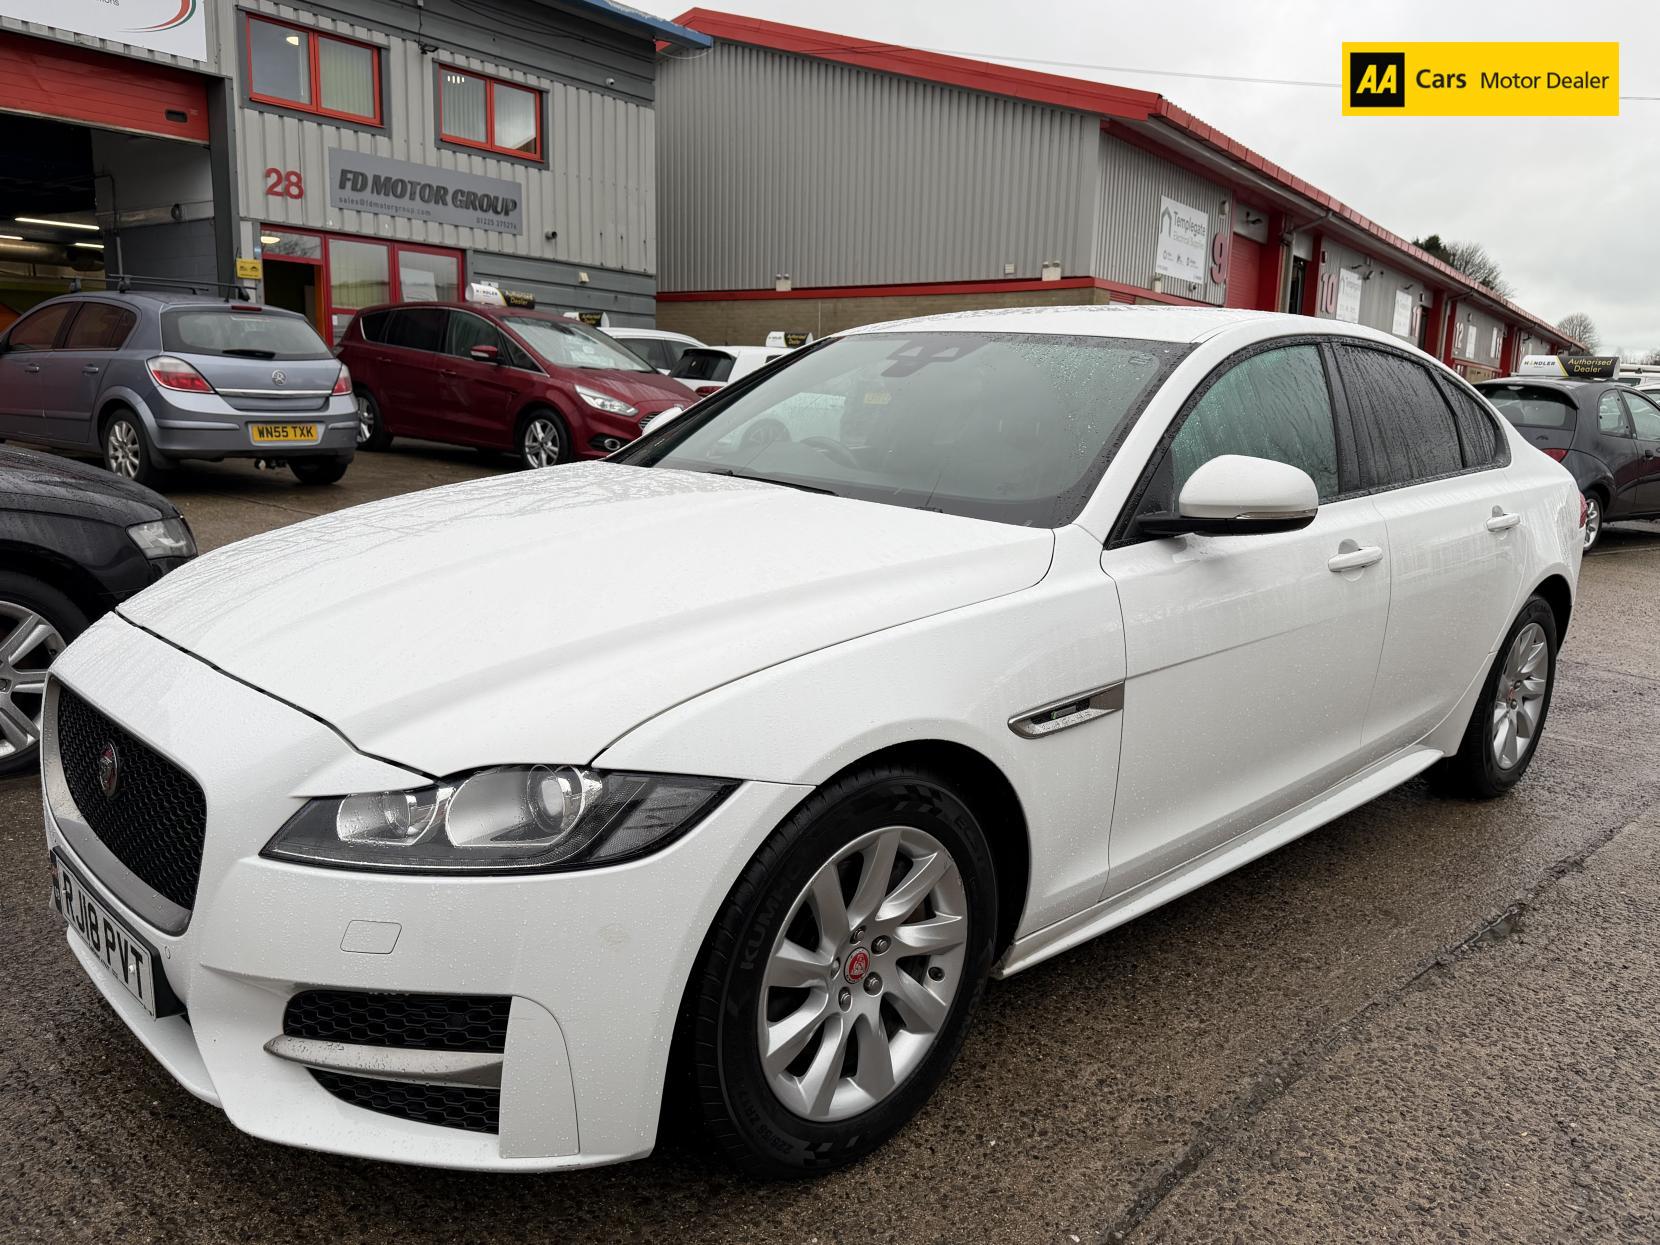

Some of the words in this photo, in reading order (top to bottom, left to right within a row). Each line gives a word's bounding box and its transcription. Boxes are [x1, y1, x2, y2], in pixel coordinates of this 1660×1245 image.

[264, 167, 305, 200] 28
[338, 168, 369, 193] FD
[370, 173, 449, 207] MOTOR
[451, 188, 518, 217] GROUP
[338, 197, 432, 217] sales@fdmotorgroup.com
[1173, 211, 1206, 237] Templegate
[1211, 231, 1228, 284] 9
[1320, 272, 1339, 314] 10
[1412, 305, 1423, 337] 11
[1455, 322, 1464, 349] 12
[1567, 358, 1612, 366] Authorised
[1573, 365, 1602, 373] Dealer
[257, 425, 289, 439] WN55
[290, 425, 313, 438] TXK
[62, 870, 101, 952] RJ18
[103, 917, 144, 1000] PVT
